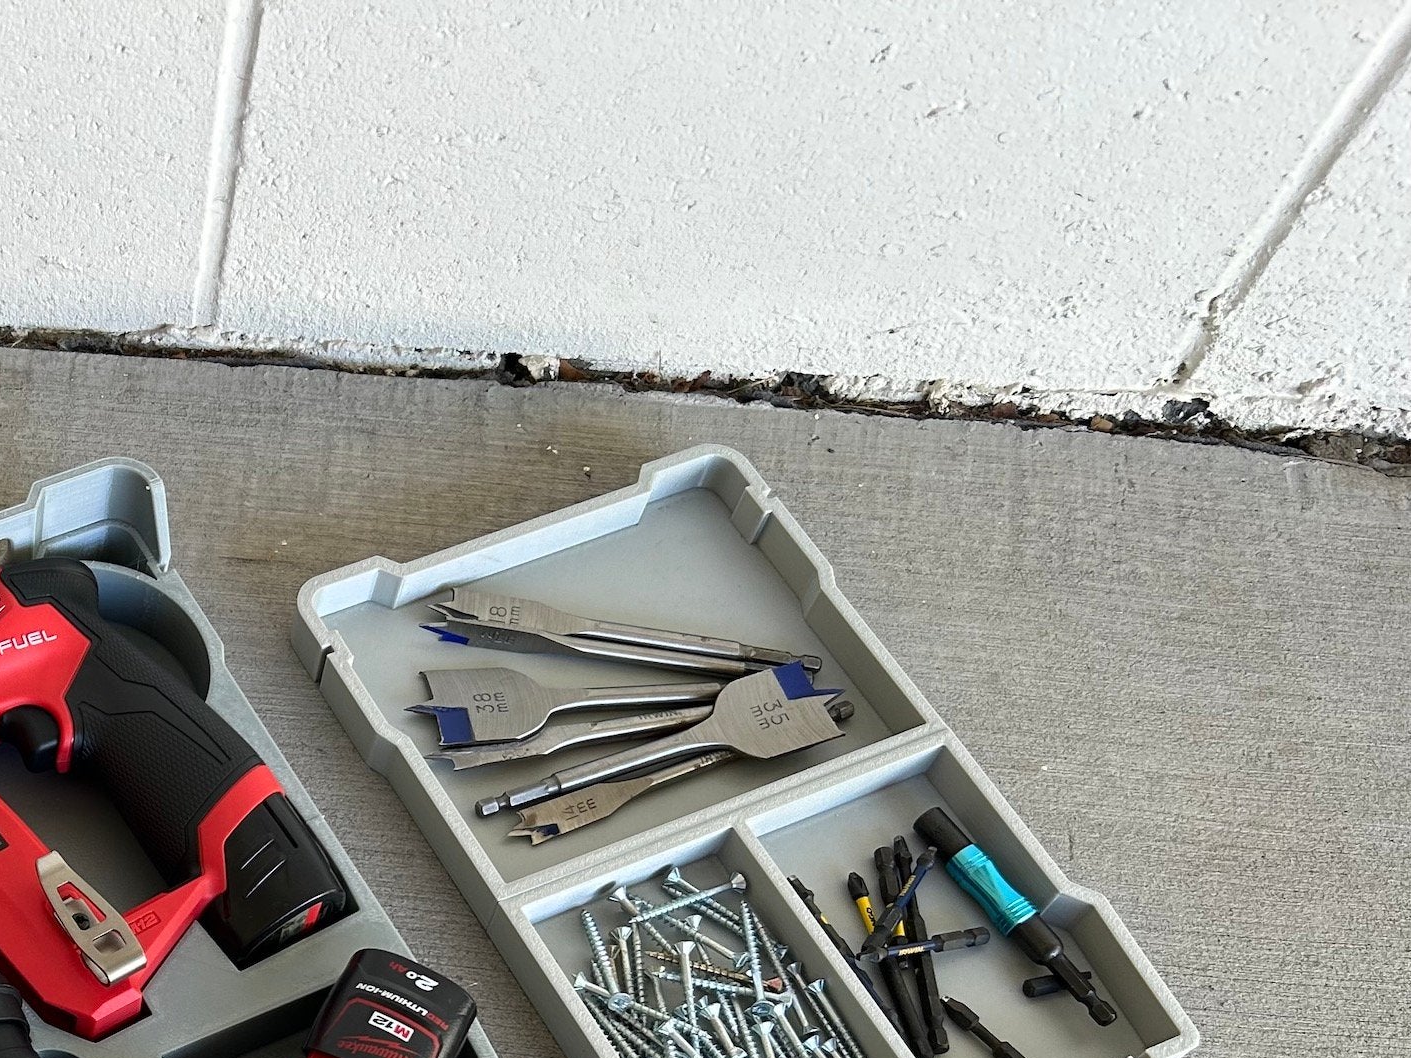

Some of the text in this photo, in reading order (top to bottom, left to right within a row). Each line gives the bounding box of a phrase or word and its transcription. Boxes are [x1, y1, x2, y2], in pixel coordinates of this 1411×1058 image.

[489, 606, 507, 624] 18
[473, 693, 495, 714] 38
[493, 692, 509, 714] mm
[763, 699, 790, 726] 35
[750, 705, 770, 731] mm
[563, 804, 580, 821] 14
[577, 798, 598, 813] mm
[405, 970, 439, 992] 2.0
[372, 1014, 411, 1039] M12
